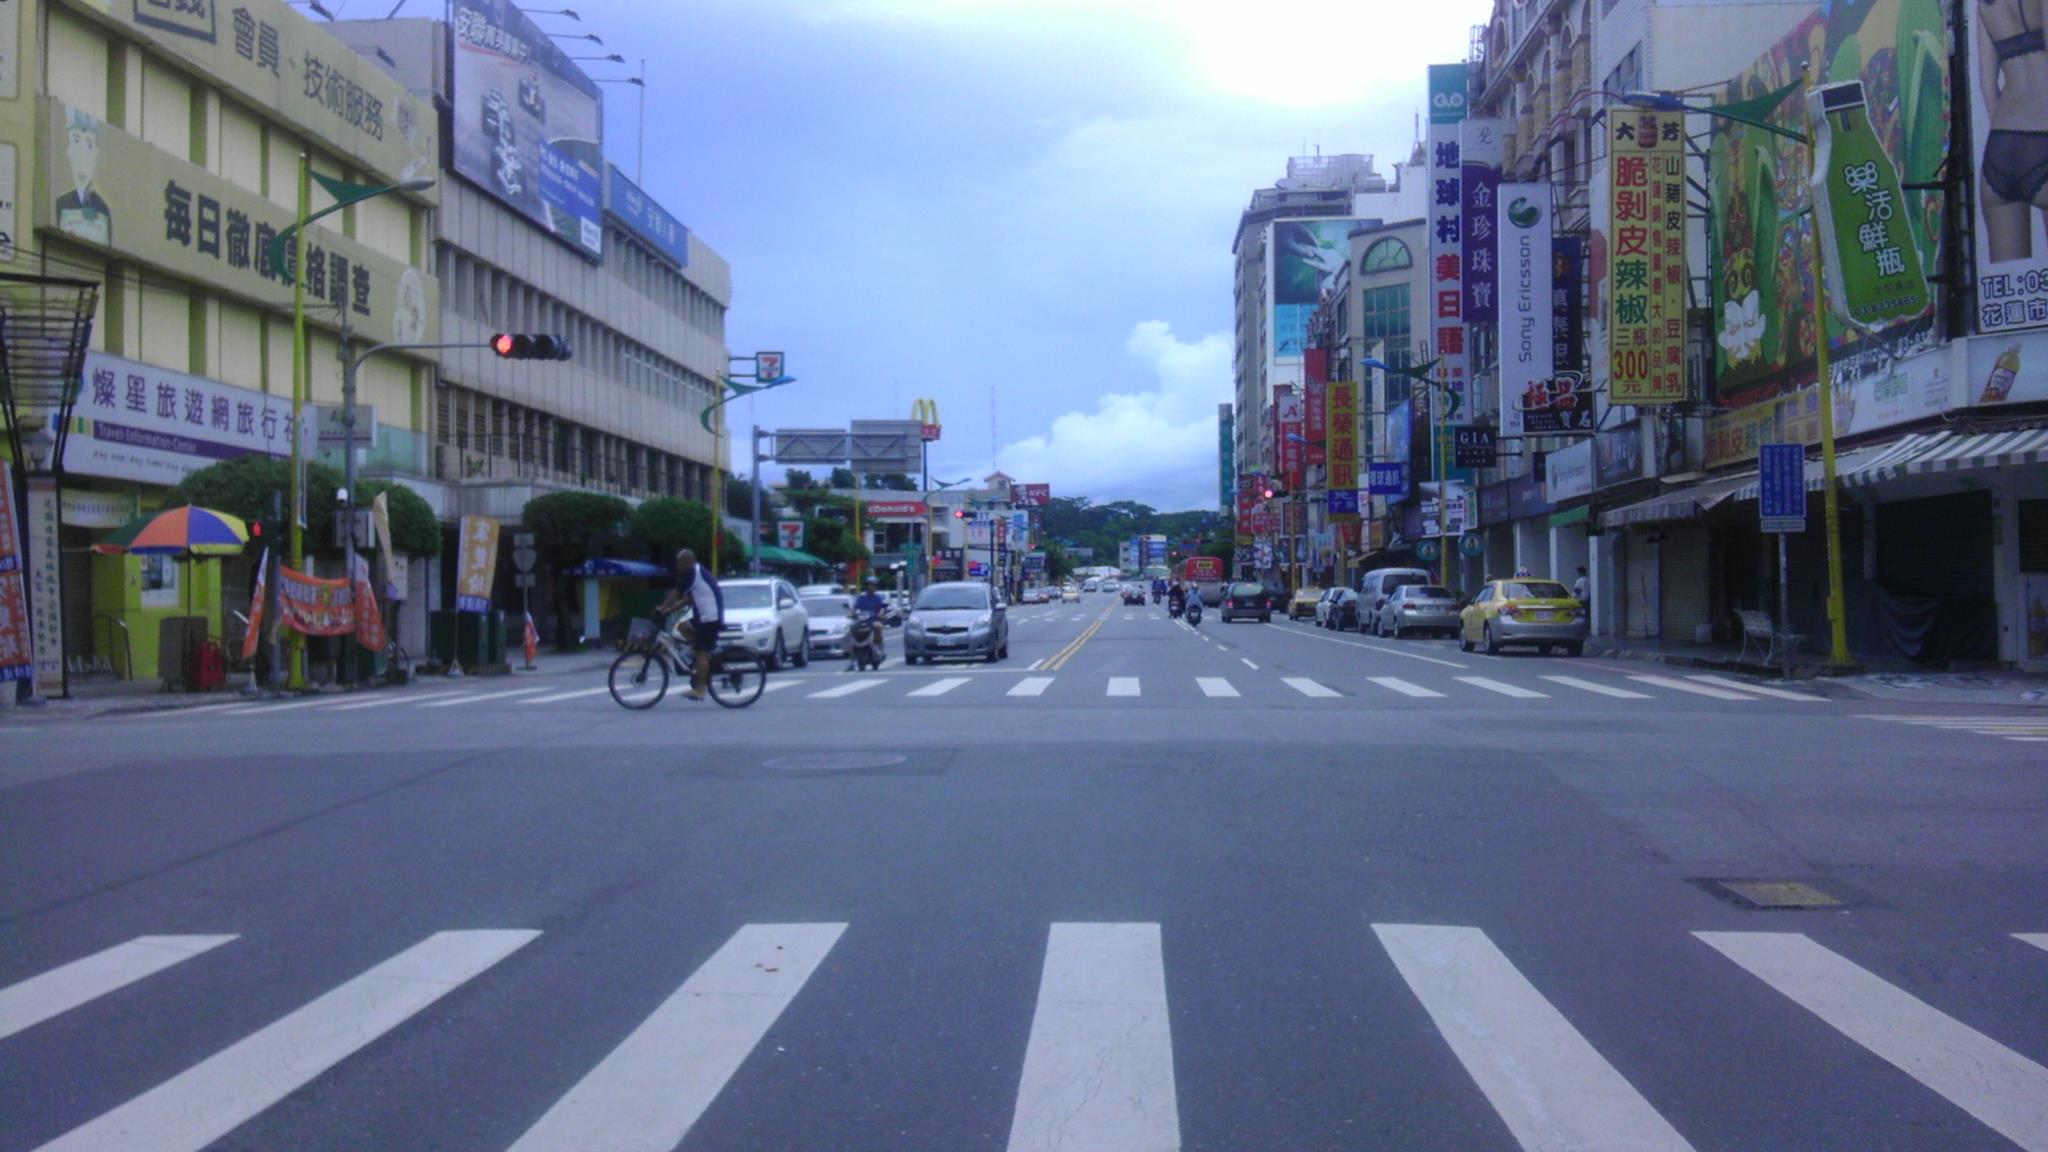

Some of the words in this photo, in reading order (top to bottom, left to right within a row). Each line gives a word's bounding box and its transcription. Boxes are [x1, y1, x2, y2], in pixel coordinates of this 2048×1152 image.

[1518, 235, 1531, 312] Ericsson
[1519, 317, 1535, 363] Sony
[1614, 350, 1648, 380] 300
[1622, 380, 1642, 394] 元
[1460, 432, 1489, 444] GIA
[1029, 489, 1048, 497] KFC
[868, 504, 915, 513] cDonald's
